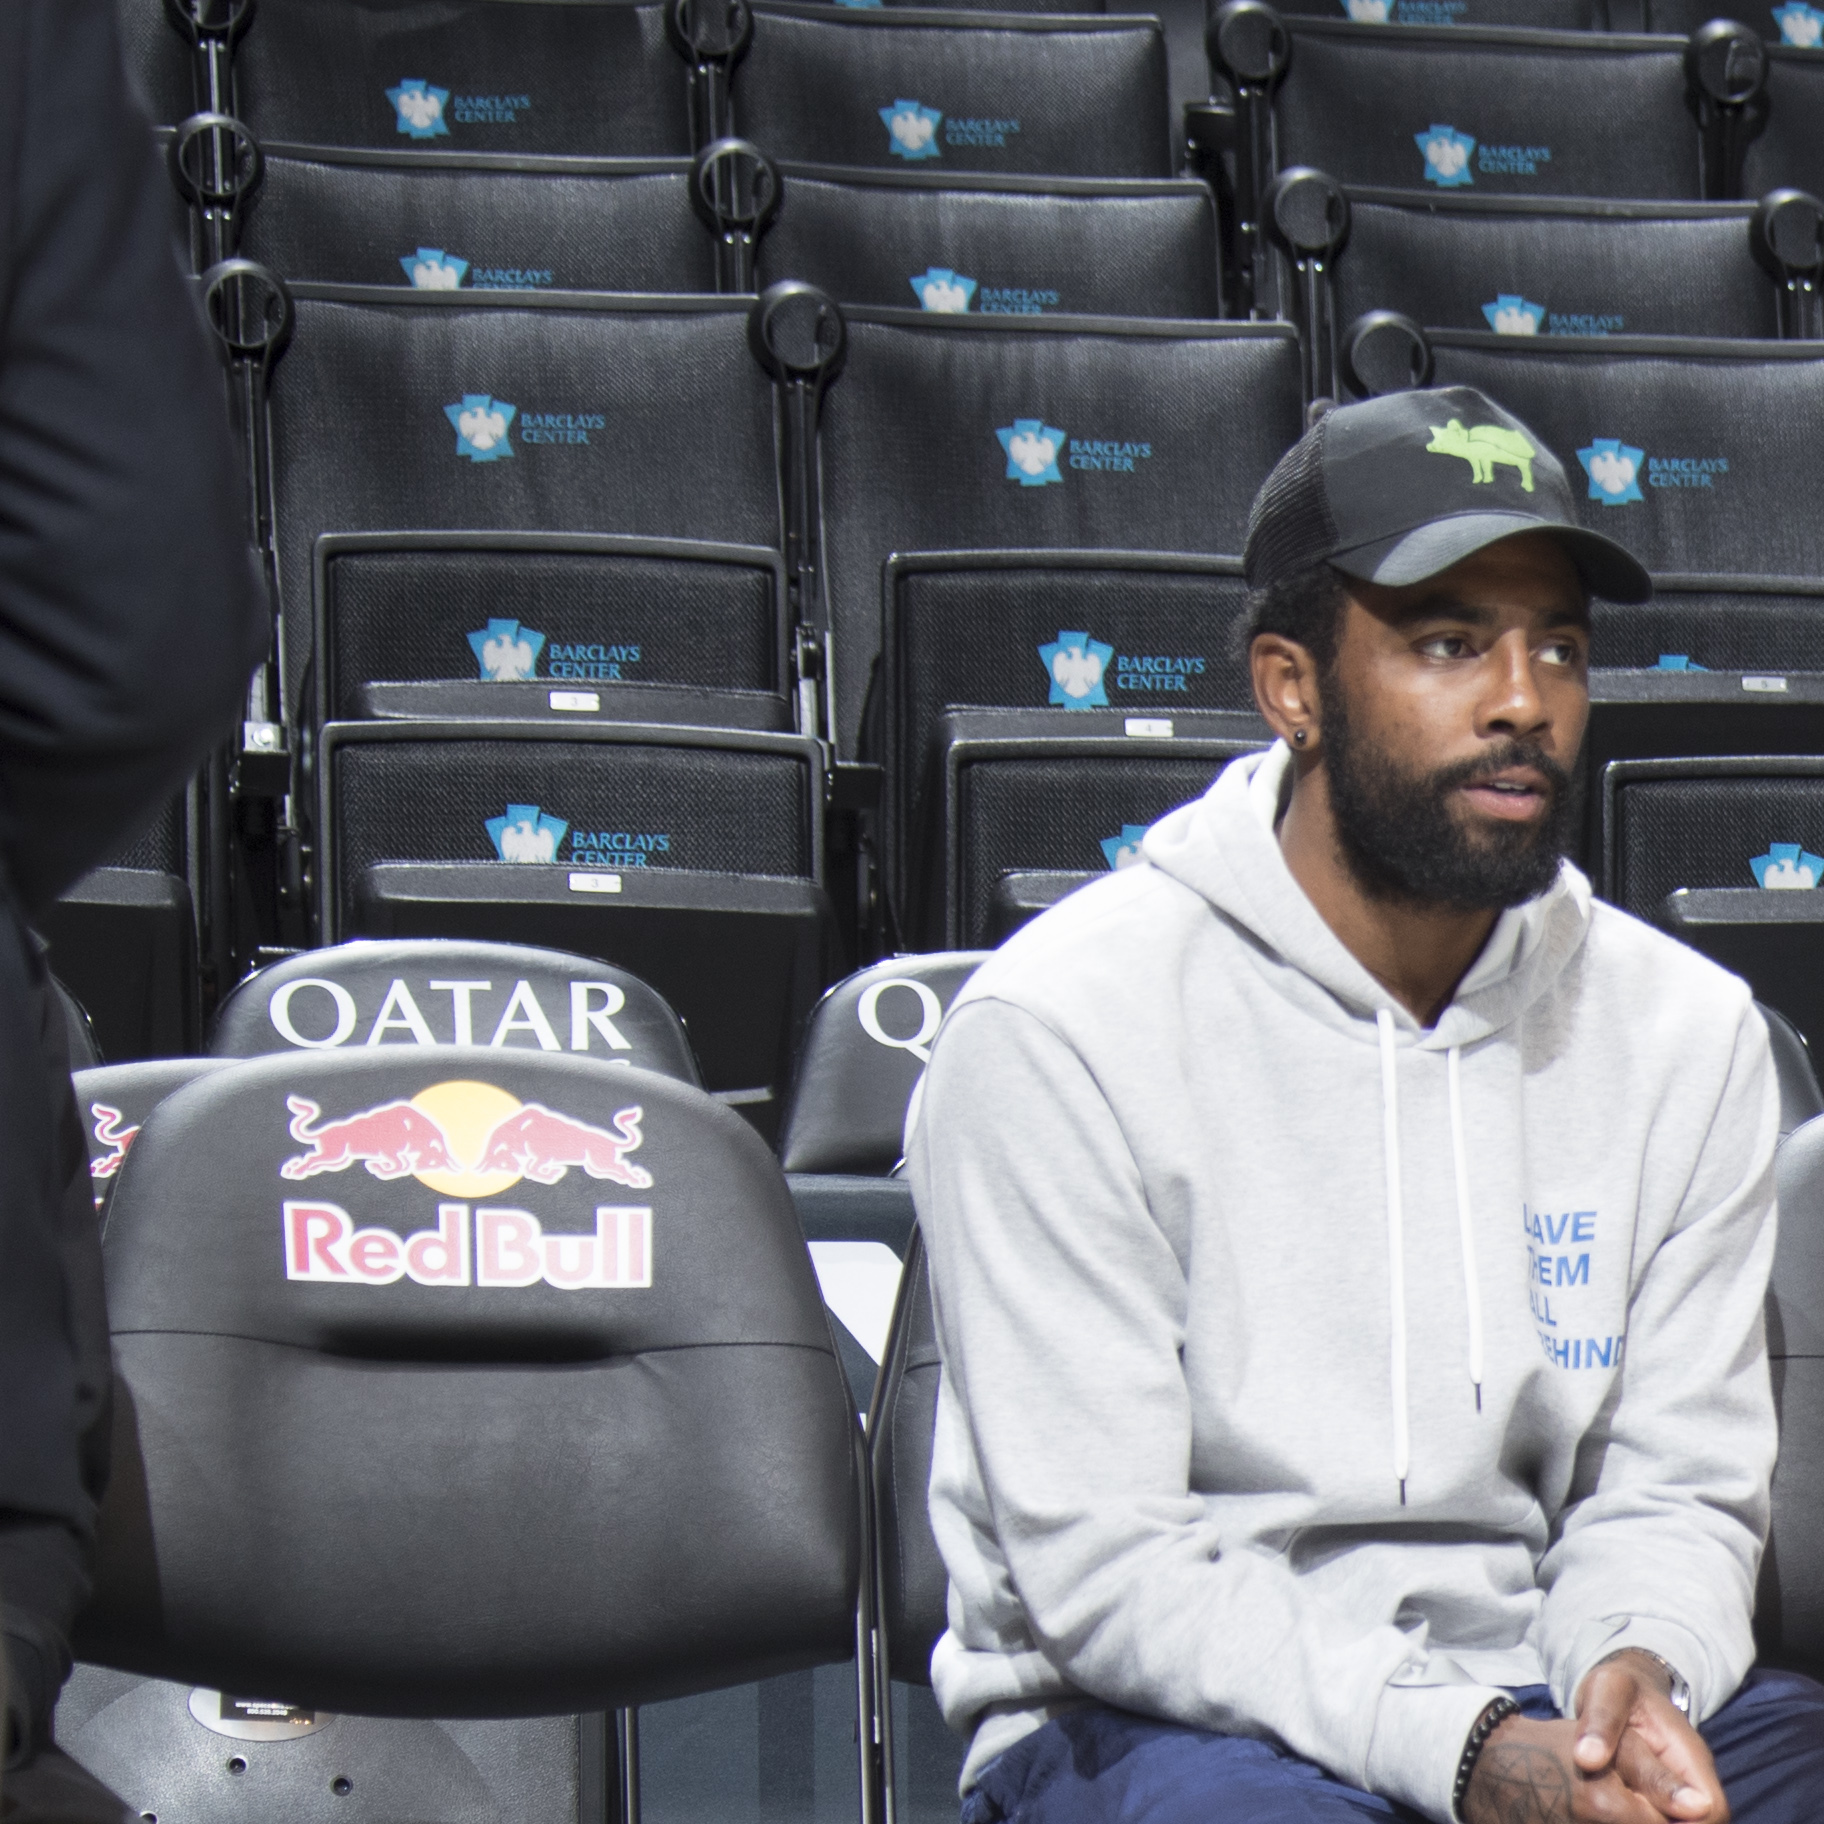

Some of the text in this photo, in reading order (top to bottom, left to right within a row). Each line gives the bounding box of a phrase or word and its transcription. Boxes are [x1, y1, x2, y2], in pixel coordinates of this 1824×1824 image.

[521, 413, 606, 429] BARCLAYS
[521, 429, 590, 445] CENTER
[1069, 438, 1152, 458] BARCLAYS
[1069, 453, 1134, 472] CENTER
[1649, 457, 1729, 473] BARCLAYS
[1649, 472, 1714, 488] CENTER
[550, 644, 640, 661] BARCLAYS
[550, 661, 621, 677] CENTER
[1117, 655, 1204, 674] BARCLAYS
[1117, 673, 1187, 691] CENTER
[572, 831, 669, 851] BARCLAYS
[572, 850, 647, 865] CENTER
[269, 978, 632, 1051] QATAR
[288, 1205, 648, 1285] Red Bull
